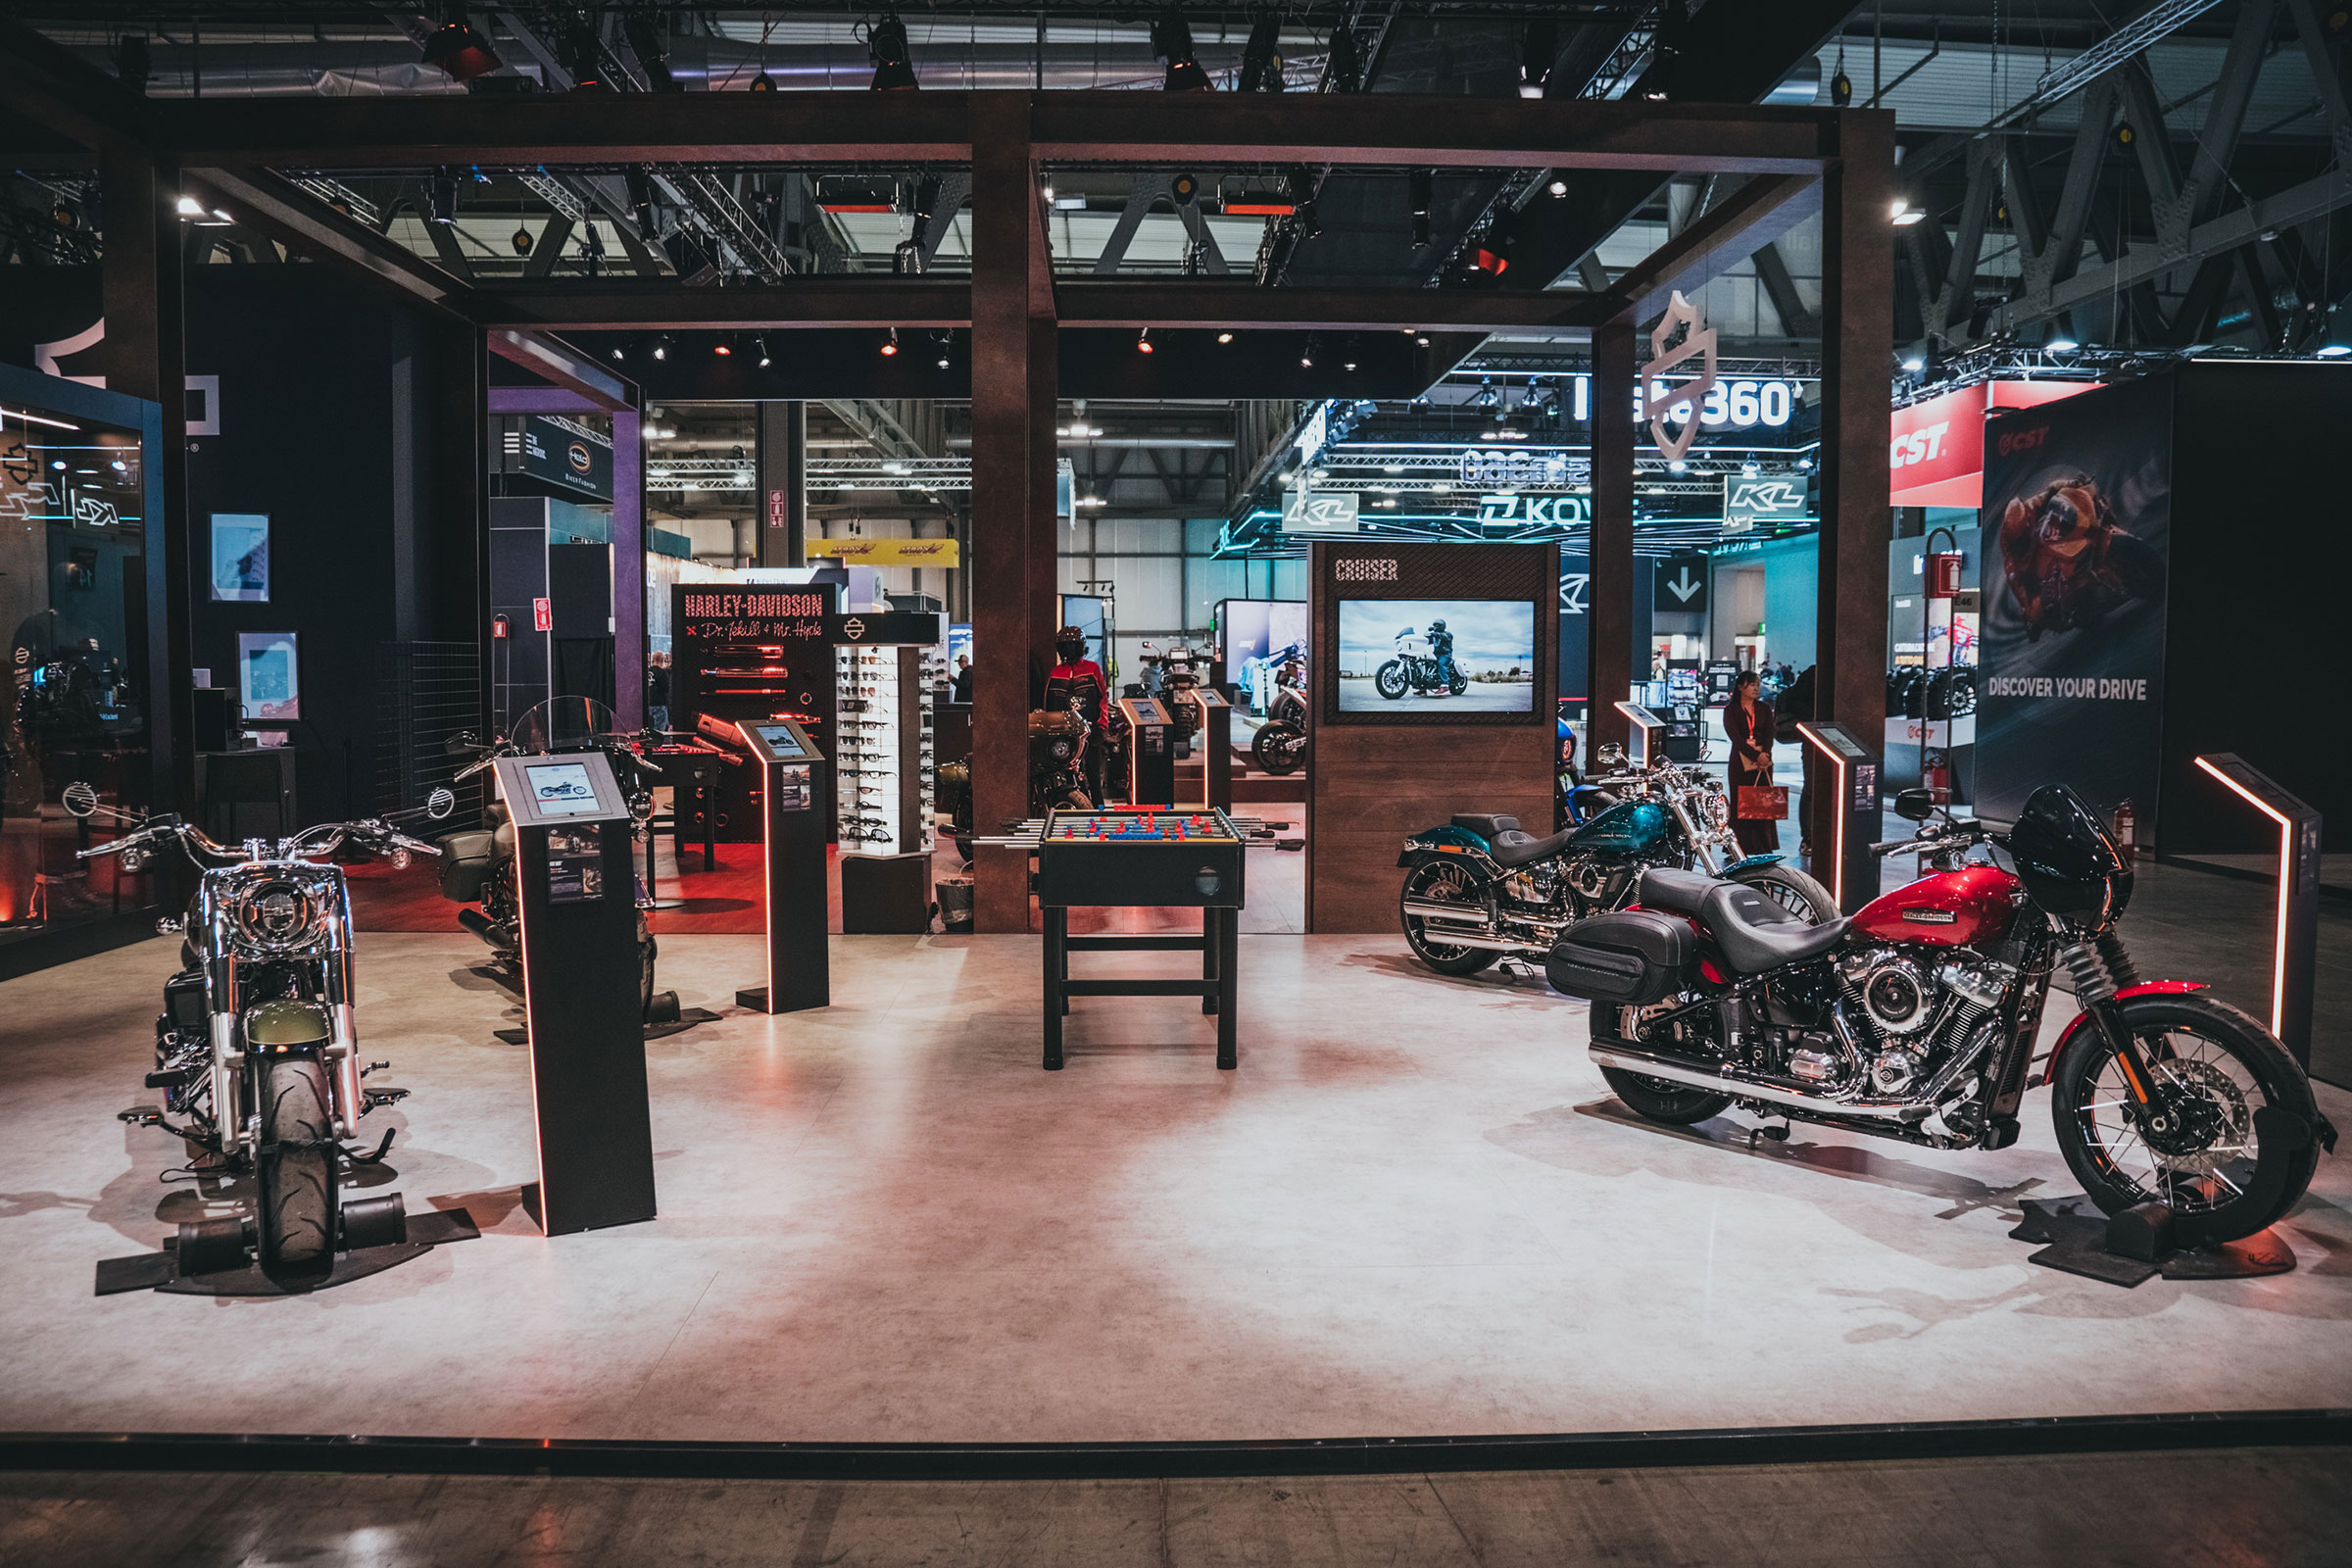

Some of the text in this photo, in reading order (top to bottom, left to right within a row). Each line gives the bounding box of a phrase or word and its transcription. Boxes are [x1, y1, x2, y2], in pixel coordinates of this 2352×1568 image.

[1575, 376, 1790, 426] Ista360
[1889, 421, 1950, 469] CST
[1335, 559, 1398, 581] CRUISER
[685, 594, 823, 617] HARLEY-DAVIDSON
[701, 622, 724, 638] Dr.
[724, 619, 761, 642] Jekill
[773, 621, 792, 637] Mr.
[792, 618, 822, 642] Hyde
[1988, 676, 2147, 701] DISCOVER YOUR DRIVE
